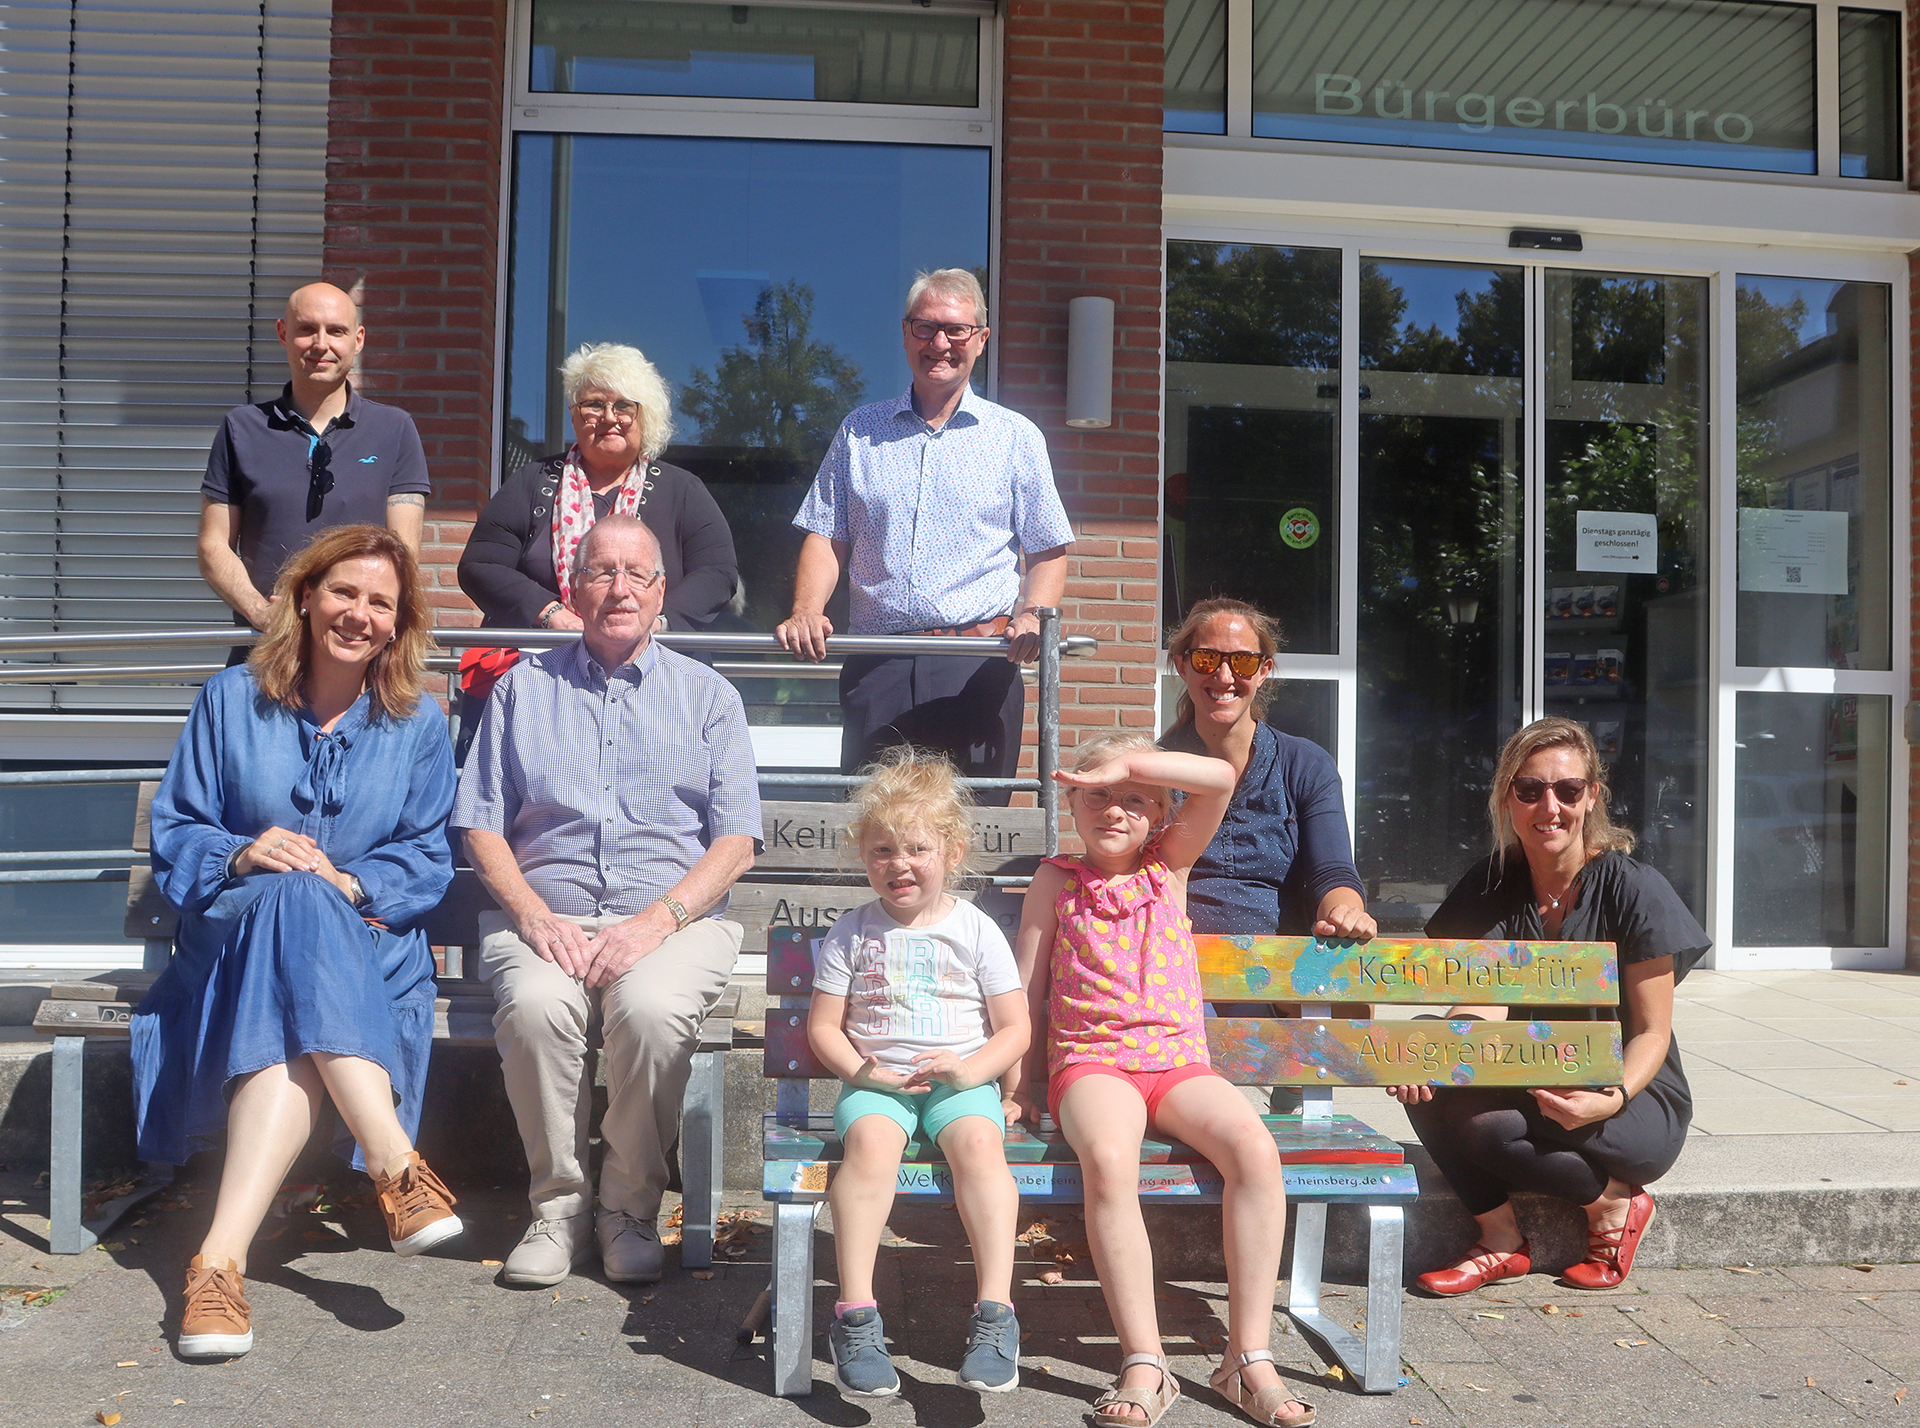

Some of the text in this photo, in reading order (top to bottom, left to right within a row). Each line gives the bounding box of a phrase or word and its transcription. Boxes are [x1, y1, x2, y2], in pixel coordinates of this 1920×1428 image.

[1315, 72, 1755, 144] Bürgerbüro
[1582, 527, 1651, 538] Dienstags ganztägig
[1594, 540, 1639, 548] geschlossen!
[862, 938, 966, 982] GIRL
[1358, 956, 1582, 989] Kein Platz für
[867, 994, 969, 1036] GIRL
[1356, 1034, 1592, 1073] Ausgrenzung!
[1051, 1176, 1076, 1185] sein
[1159, 1178, 1180, 1186] an.
